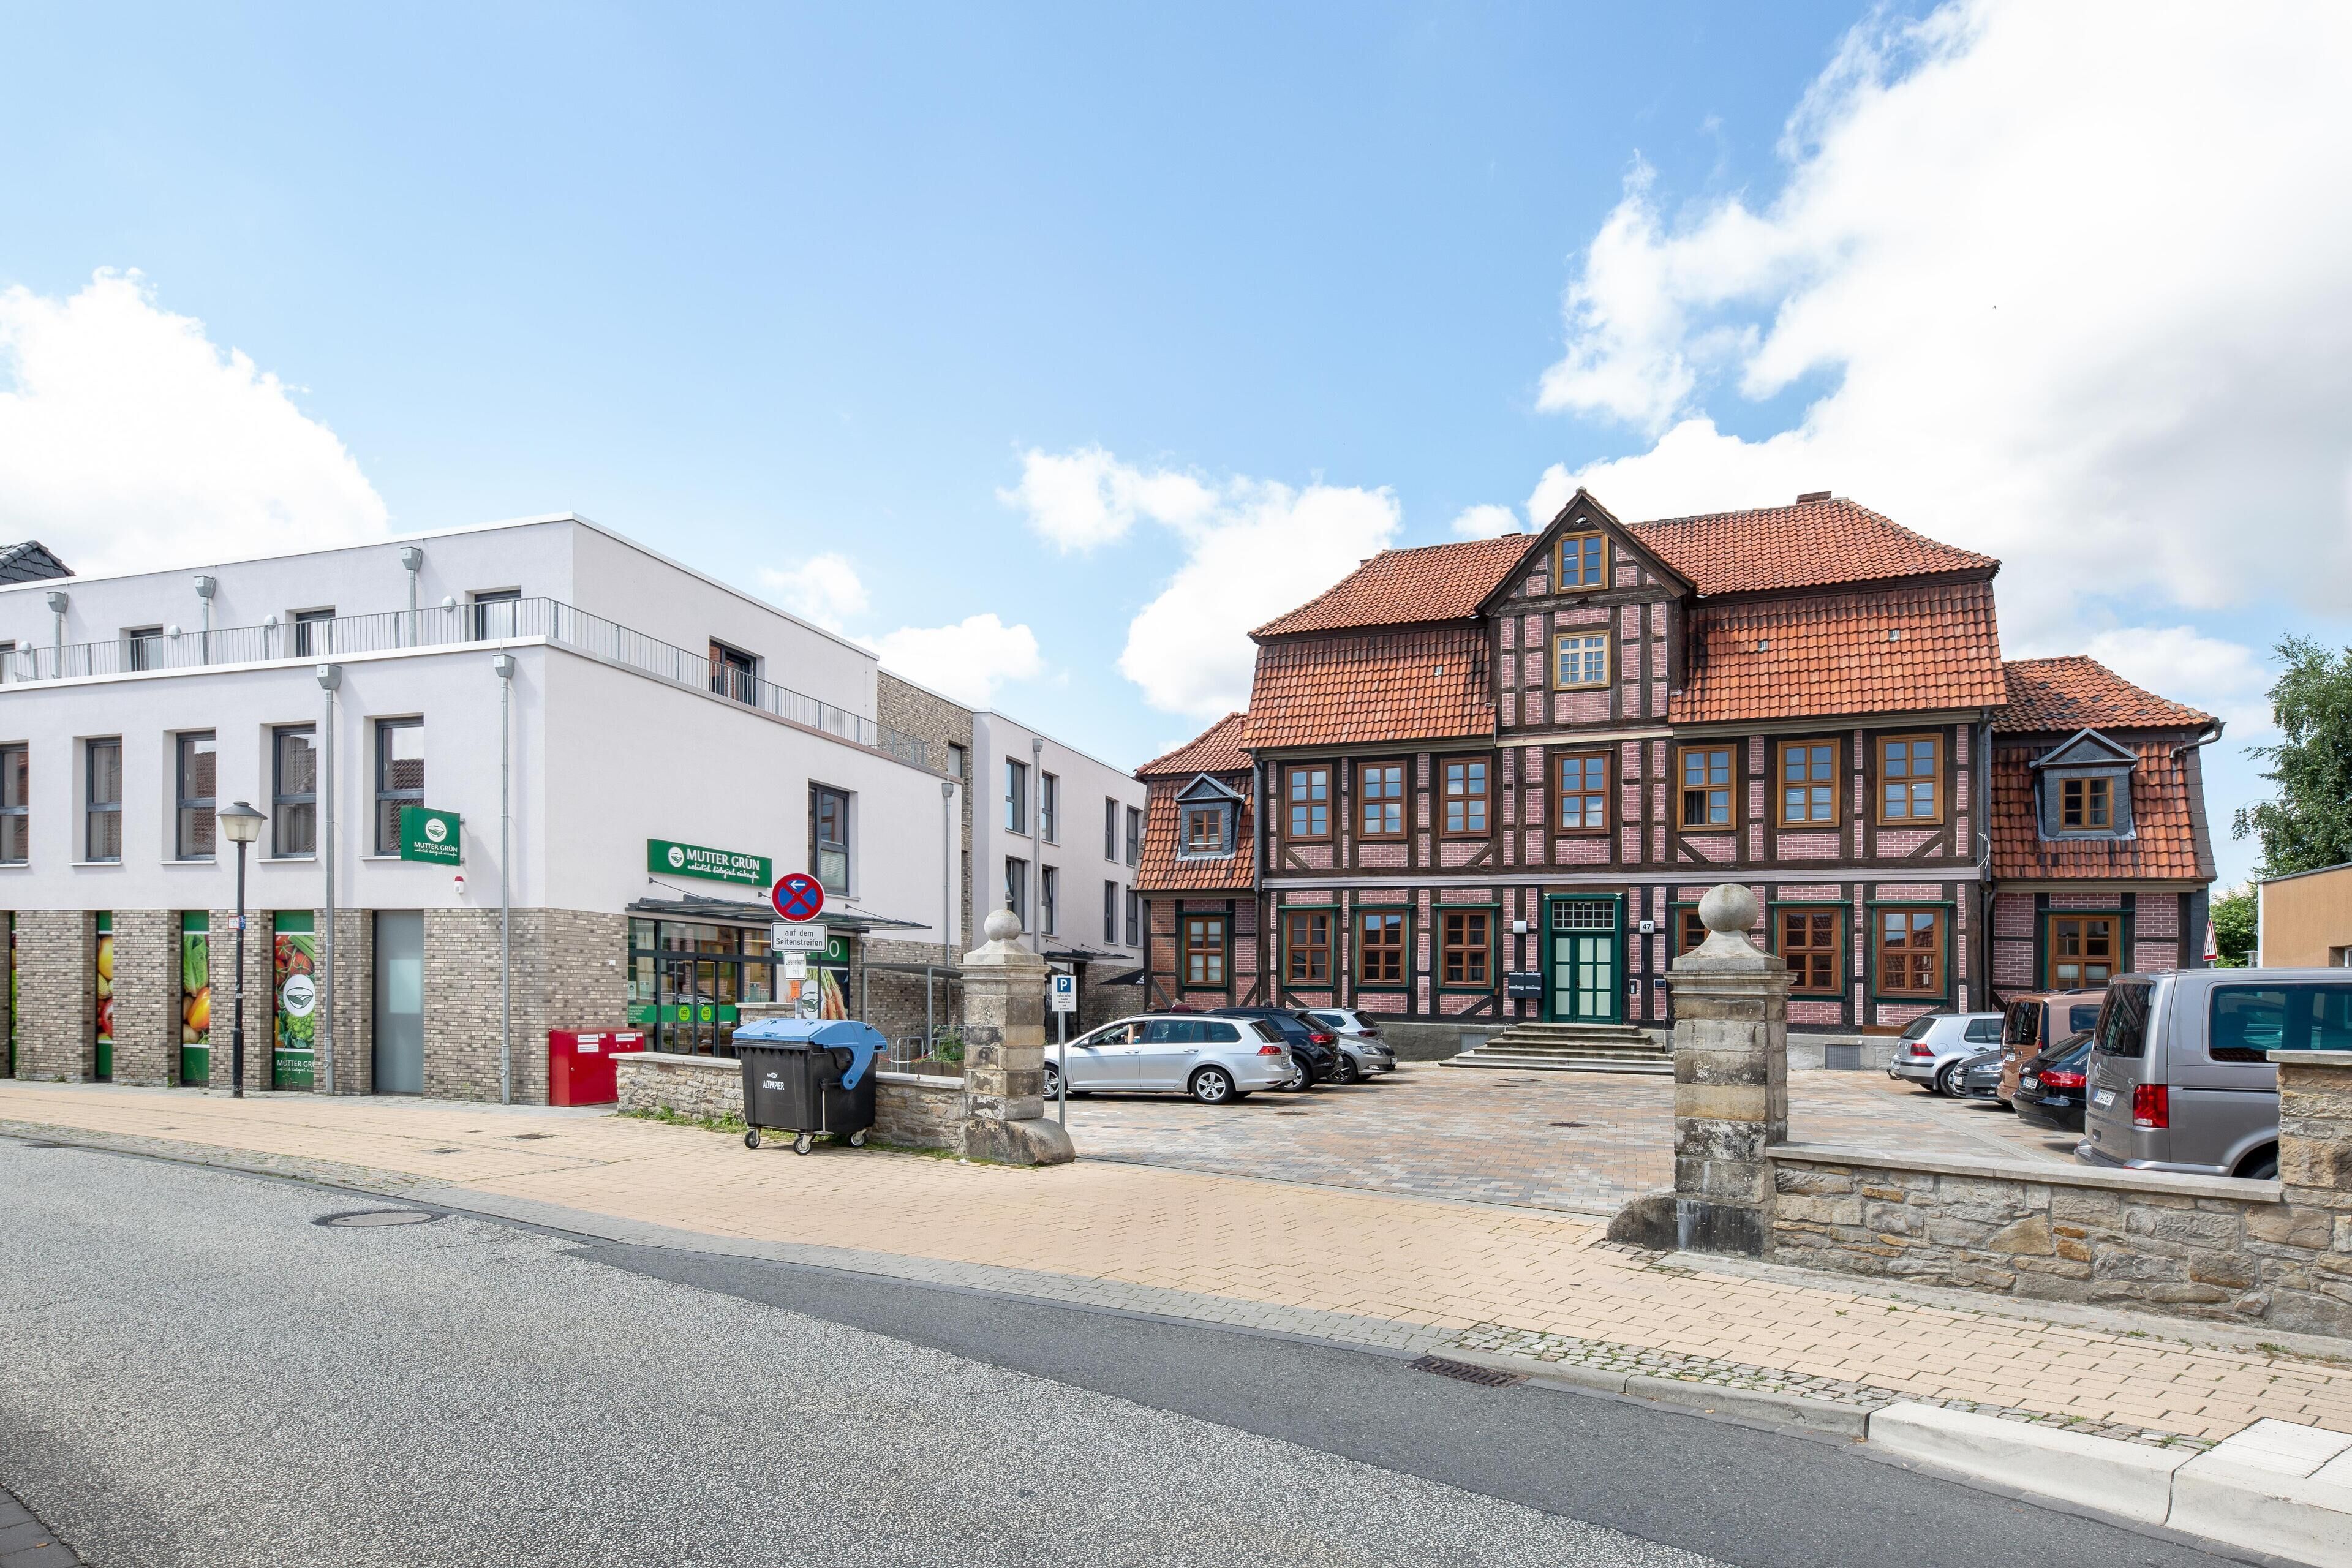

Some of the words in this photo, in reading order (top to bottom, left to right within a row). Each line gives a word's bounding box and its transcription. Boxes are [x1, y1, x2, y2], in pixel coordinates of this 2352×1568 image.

[414, 841, 439, 850] MUTTER
[687, 848, 729, 866] MUTTER
[731, 856, 760, 871] GRÜN
[775, 937, 823, 946] Seitenstreifen
[1060, 979, 1068, 991] P
[763, 1080, 785, 1090] ALTPAPIER
